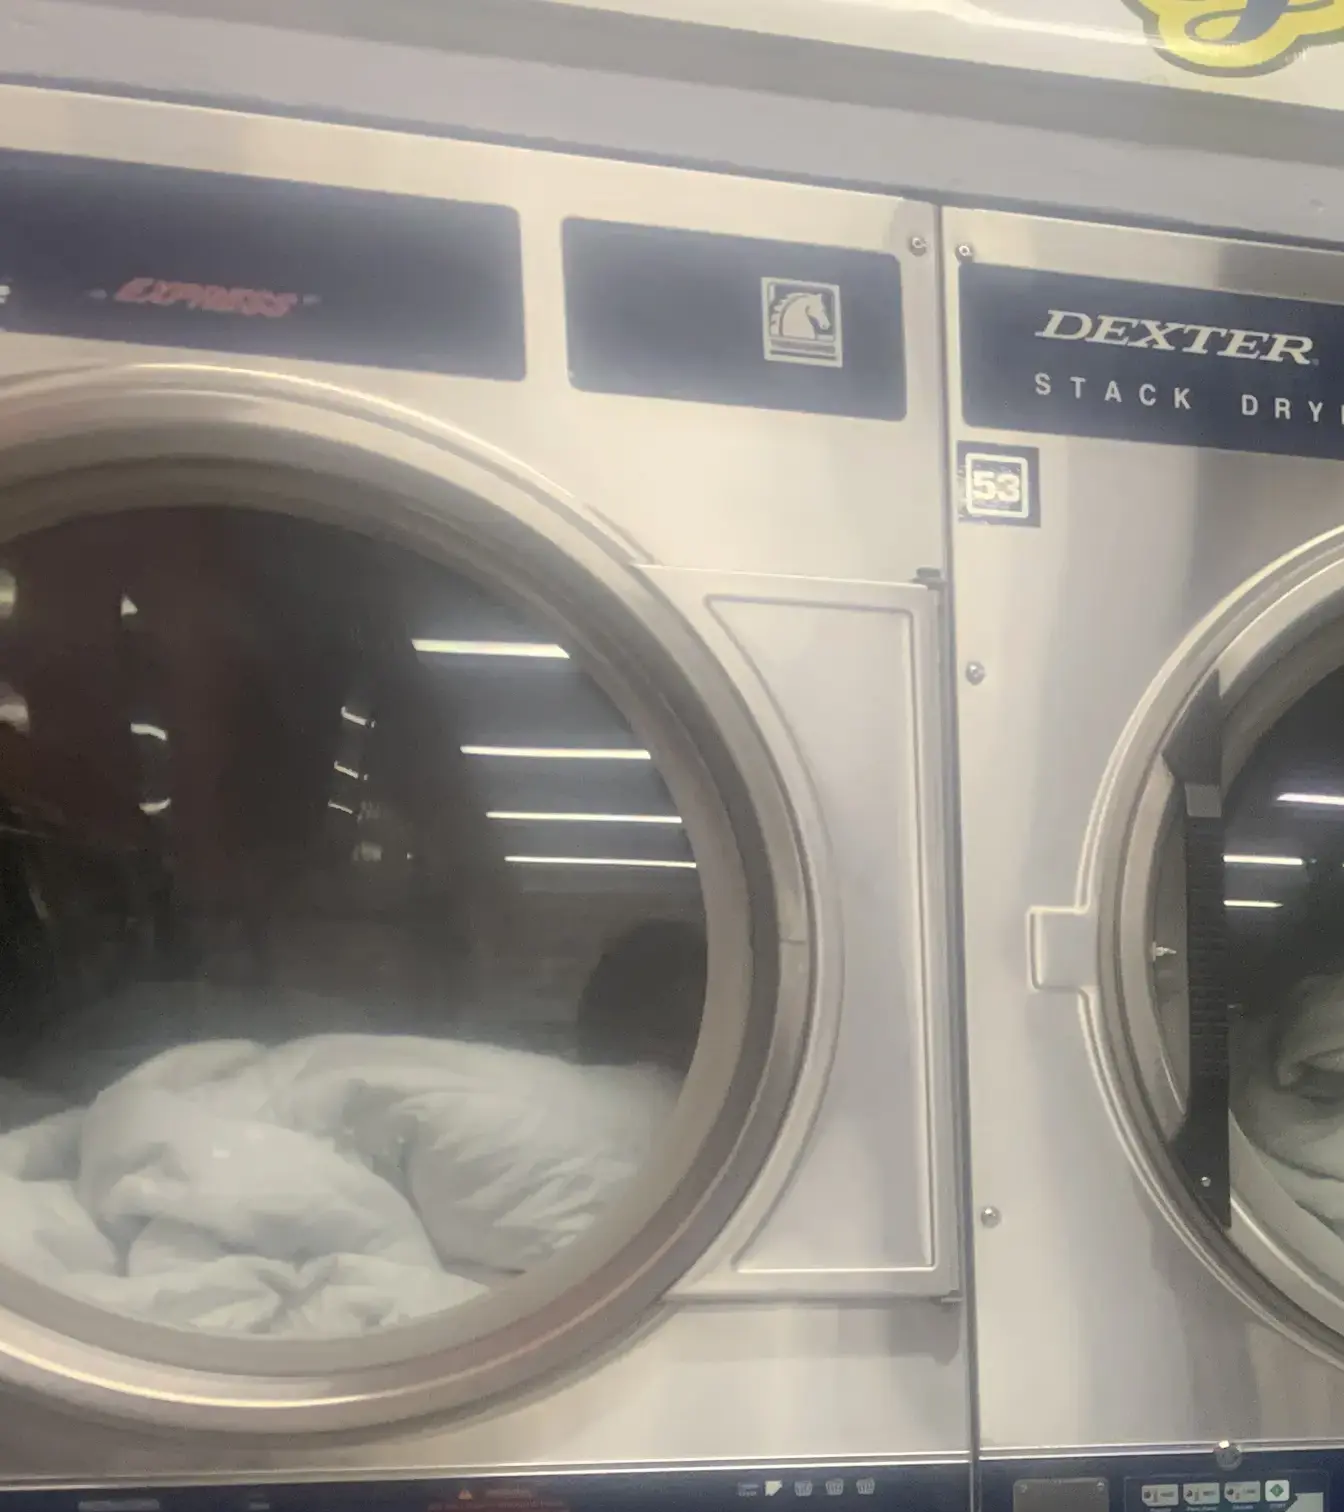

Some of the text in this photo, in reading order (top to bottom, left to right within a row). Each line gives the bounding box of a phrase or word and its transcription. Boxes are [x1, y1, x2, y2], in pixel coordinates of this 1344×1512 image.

[1034, 310, 1315, 365] DEXTER
[1034, 372, 1193, 410] STACK
[973, 470, 1019, 502] 53
